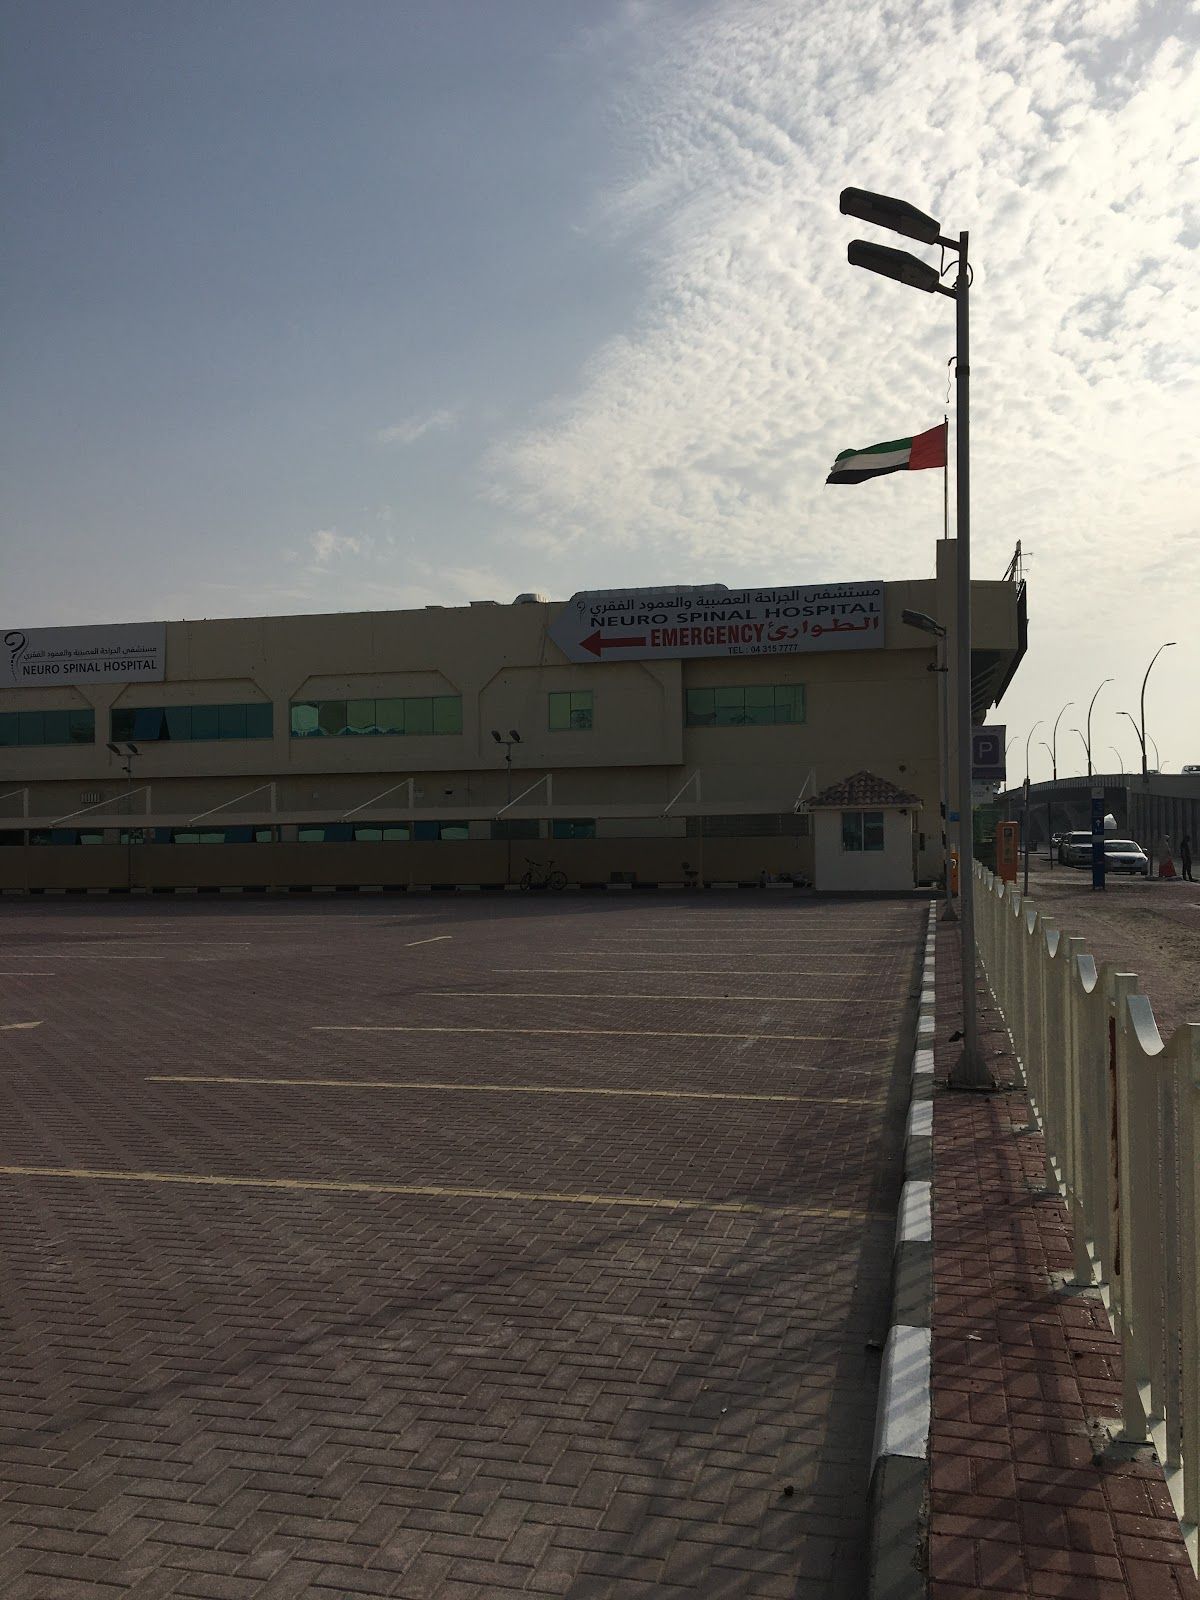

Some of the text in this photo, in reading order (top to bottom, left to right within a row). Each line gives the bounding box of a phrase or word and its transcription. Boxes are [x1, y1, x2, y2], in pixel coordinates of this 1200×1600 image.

[590, 587, 880, 617] مستشفى الجراحة العصبية والعمود الفقري
[590, 602, 881, 627] NEURO SPINAL HOSPITAL
[651, 623, 765, 647] EMERGENCY
[767, 616, 879, 641] الطوارئ
[750, 645, 760, 653] 04
[762, 644, 777, 653] 315
[778, 643, 798, 652] 7777
[23, 659, 157, 676] NEURO SPINAL HOSPITAL
[979, 741, 993, 759] P
